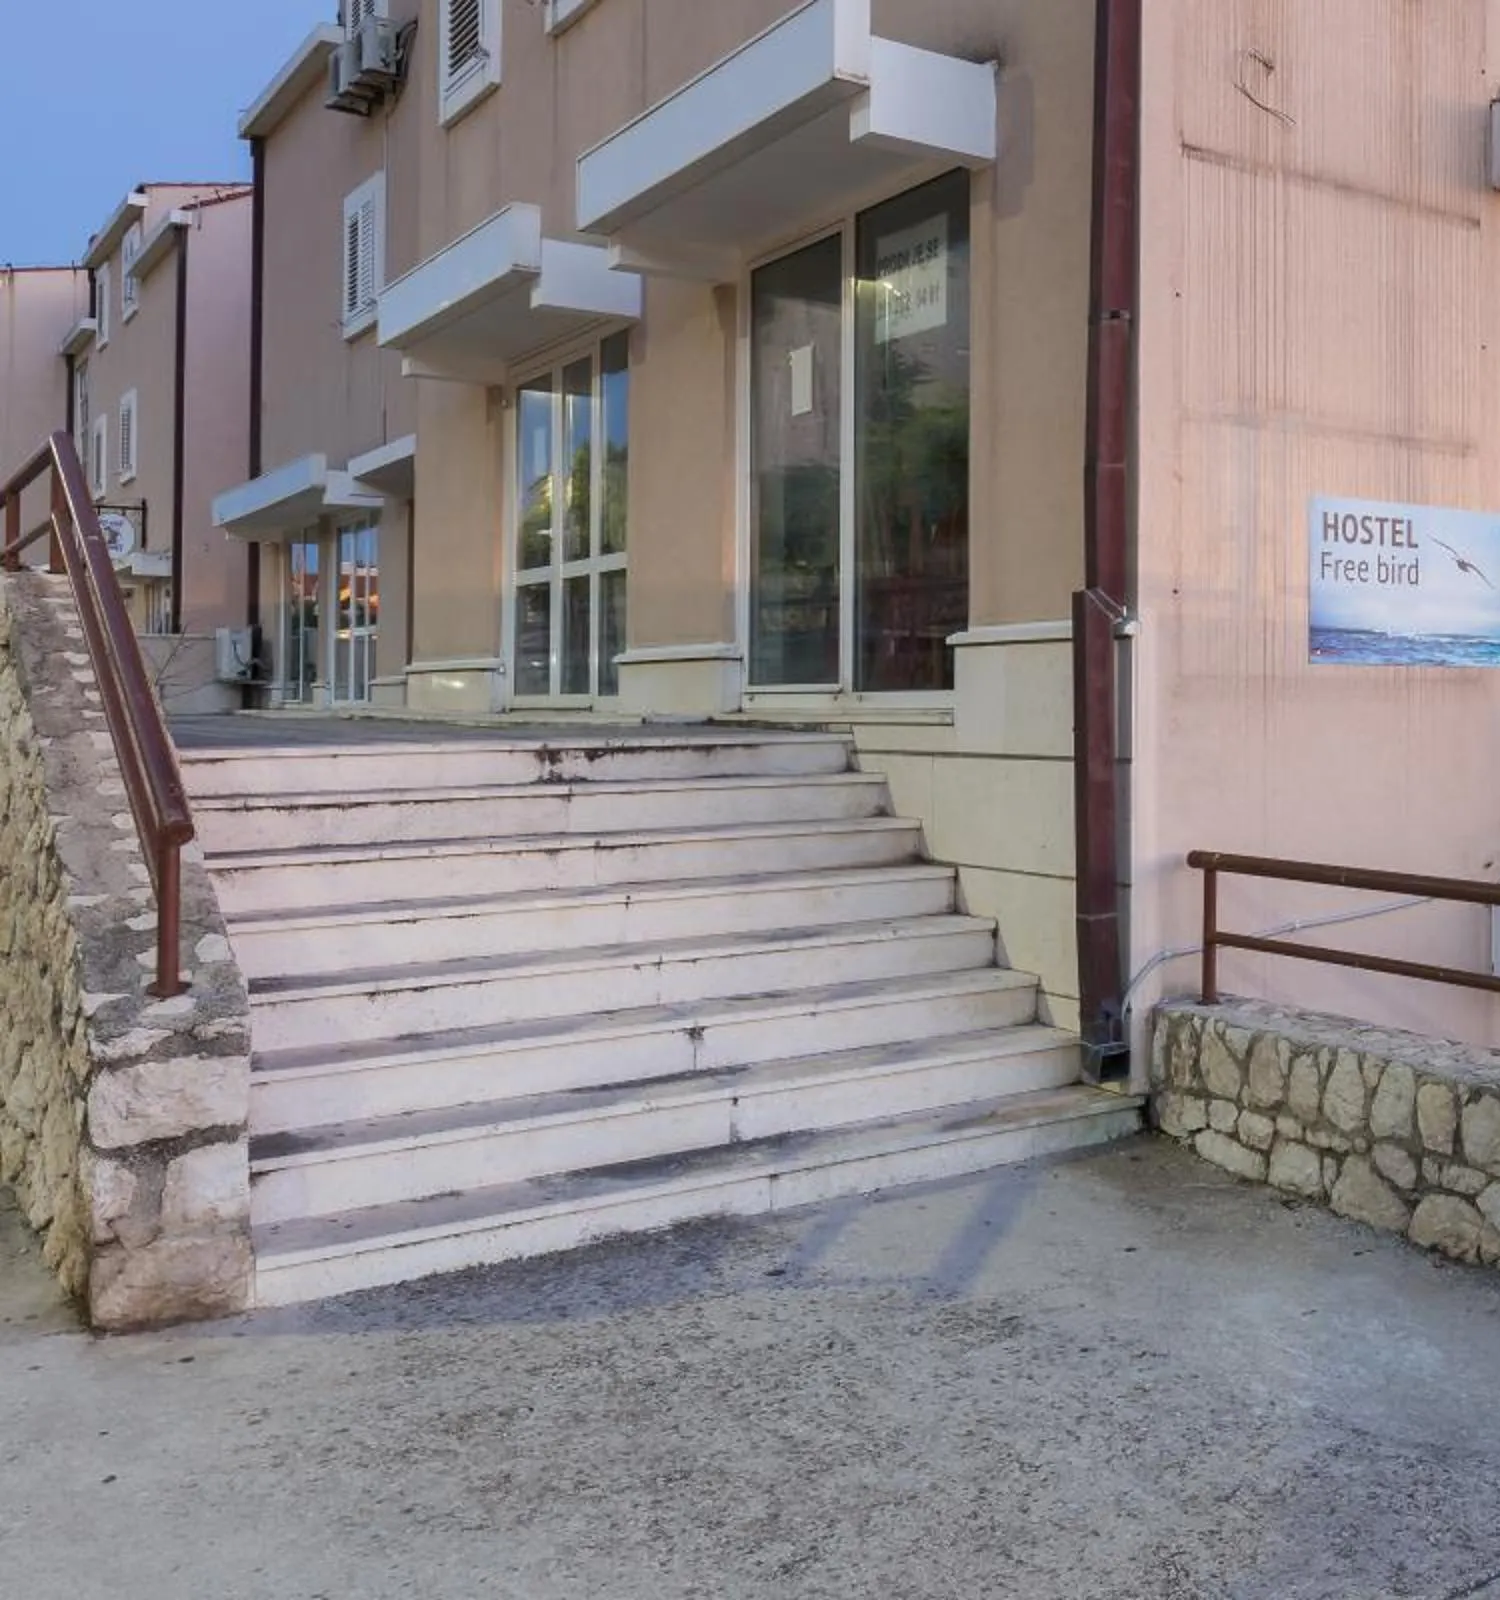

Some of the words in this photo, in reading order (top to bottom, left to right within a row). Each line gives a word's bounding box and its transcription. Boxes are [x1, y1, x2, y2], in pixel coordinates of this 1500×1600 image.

[1322, 511, 1419, 549] HOSTEL
[1321, 551, 1368, 582] Free
[1377, 553, 1420, 585] bird
